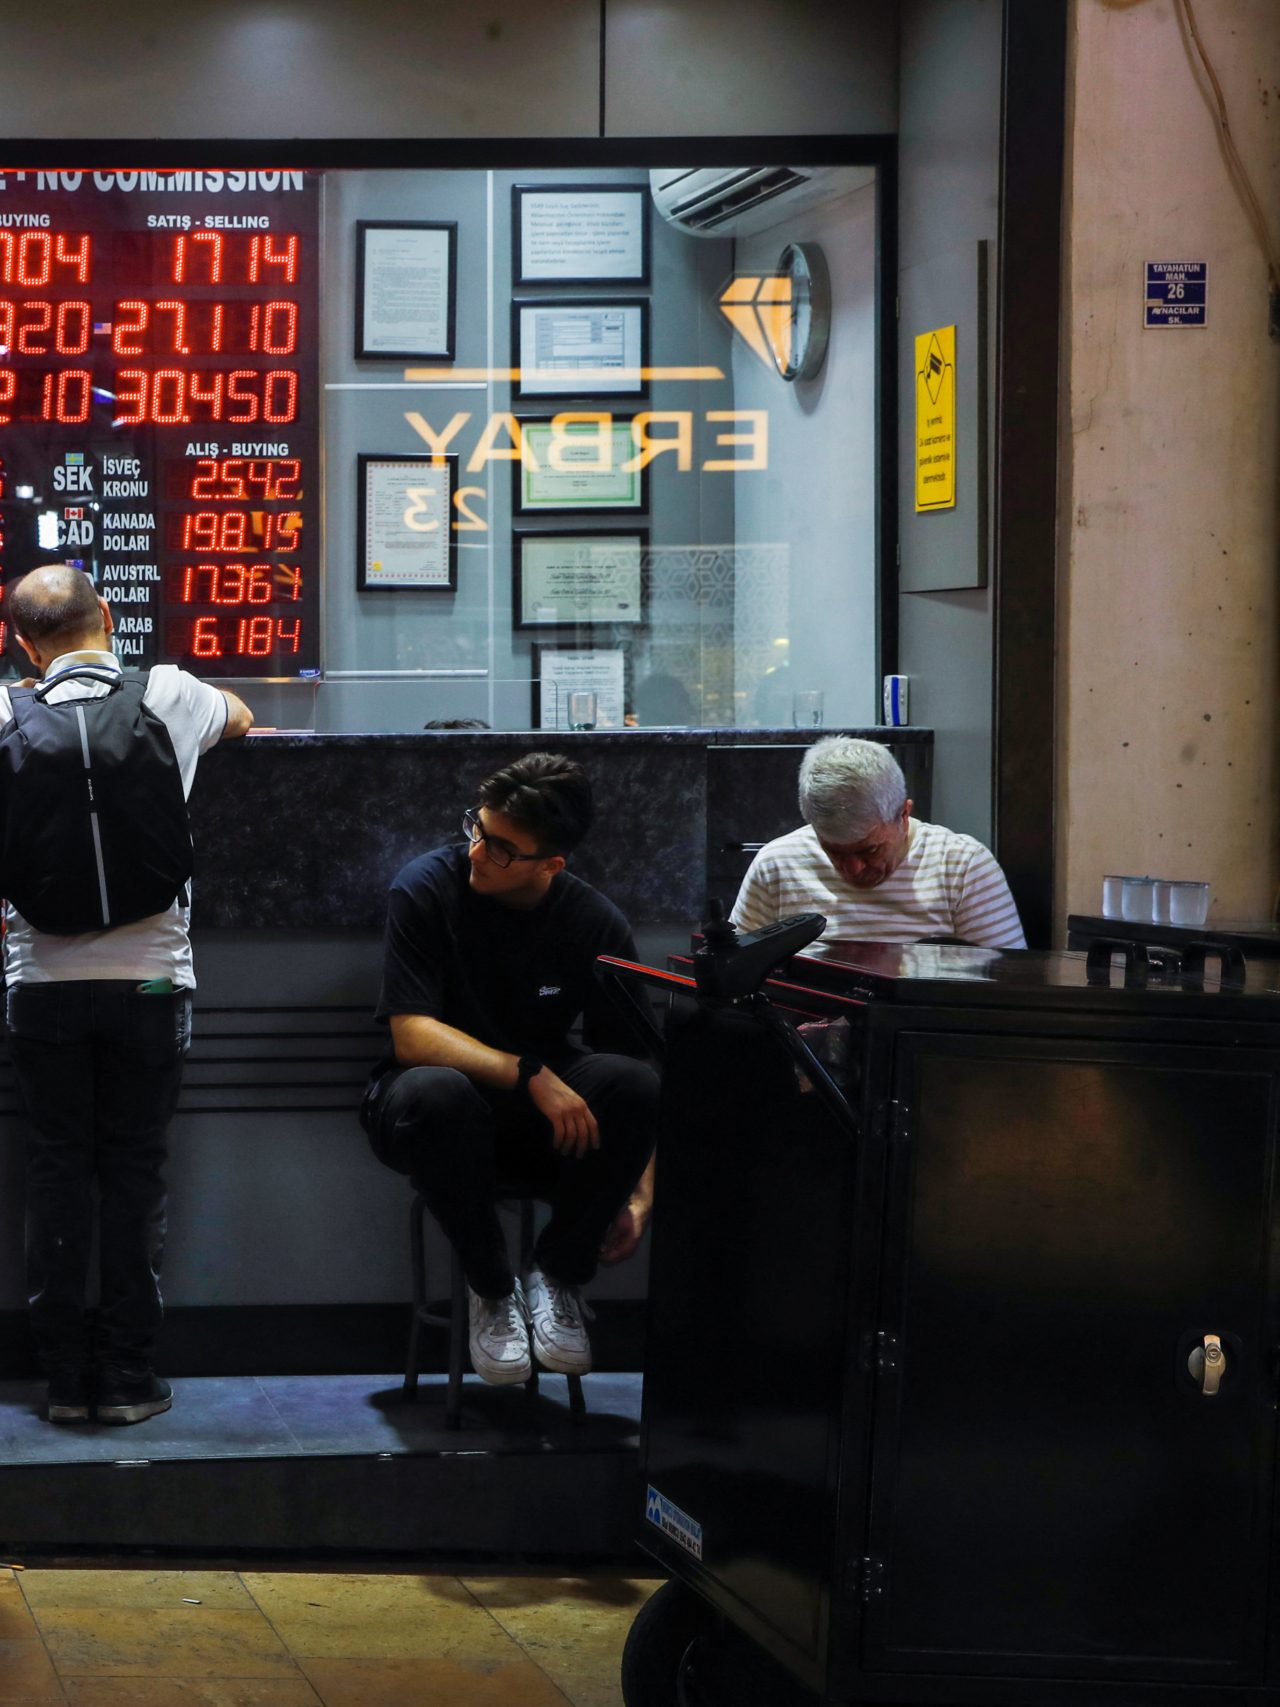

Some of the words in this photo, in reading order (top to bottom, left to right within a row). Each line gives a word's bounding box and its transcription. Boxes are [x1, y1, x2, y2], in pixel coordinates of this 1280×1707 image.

[147, 215, 191, 230] SATIŞ
[205, 215, 270, 229] SELLING
[174, 232, 298, 284] 1714
[1168, 283, 1185, 299] 26
[186, 443, 219, 458] ALIŞ
[232, 443, 289, 456] BUYING
[103, 455, 141, 478] İSVEÇ
[53, 466, 93, 491] SEK
[103, 481, 148, 497] KRONU
[103, 513, 156, 529] KANADA
[103, 535, 150, 551] DOLARI
[103, 565, 161, 580] AVUSTRL
[103, 586, 150, 602] DOLARI
[119, 617, 153, 633] ARAB
